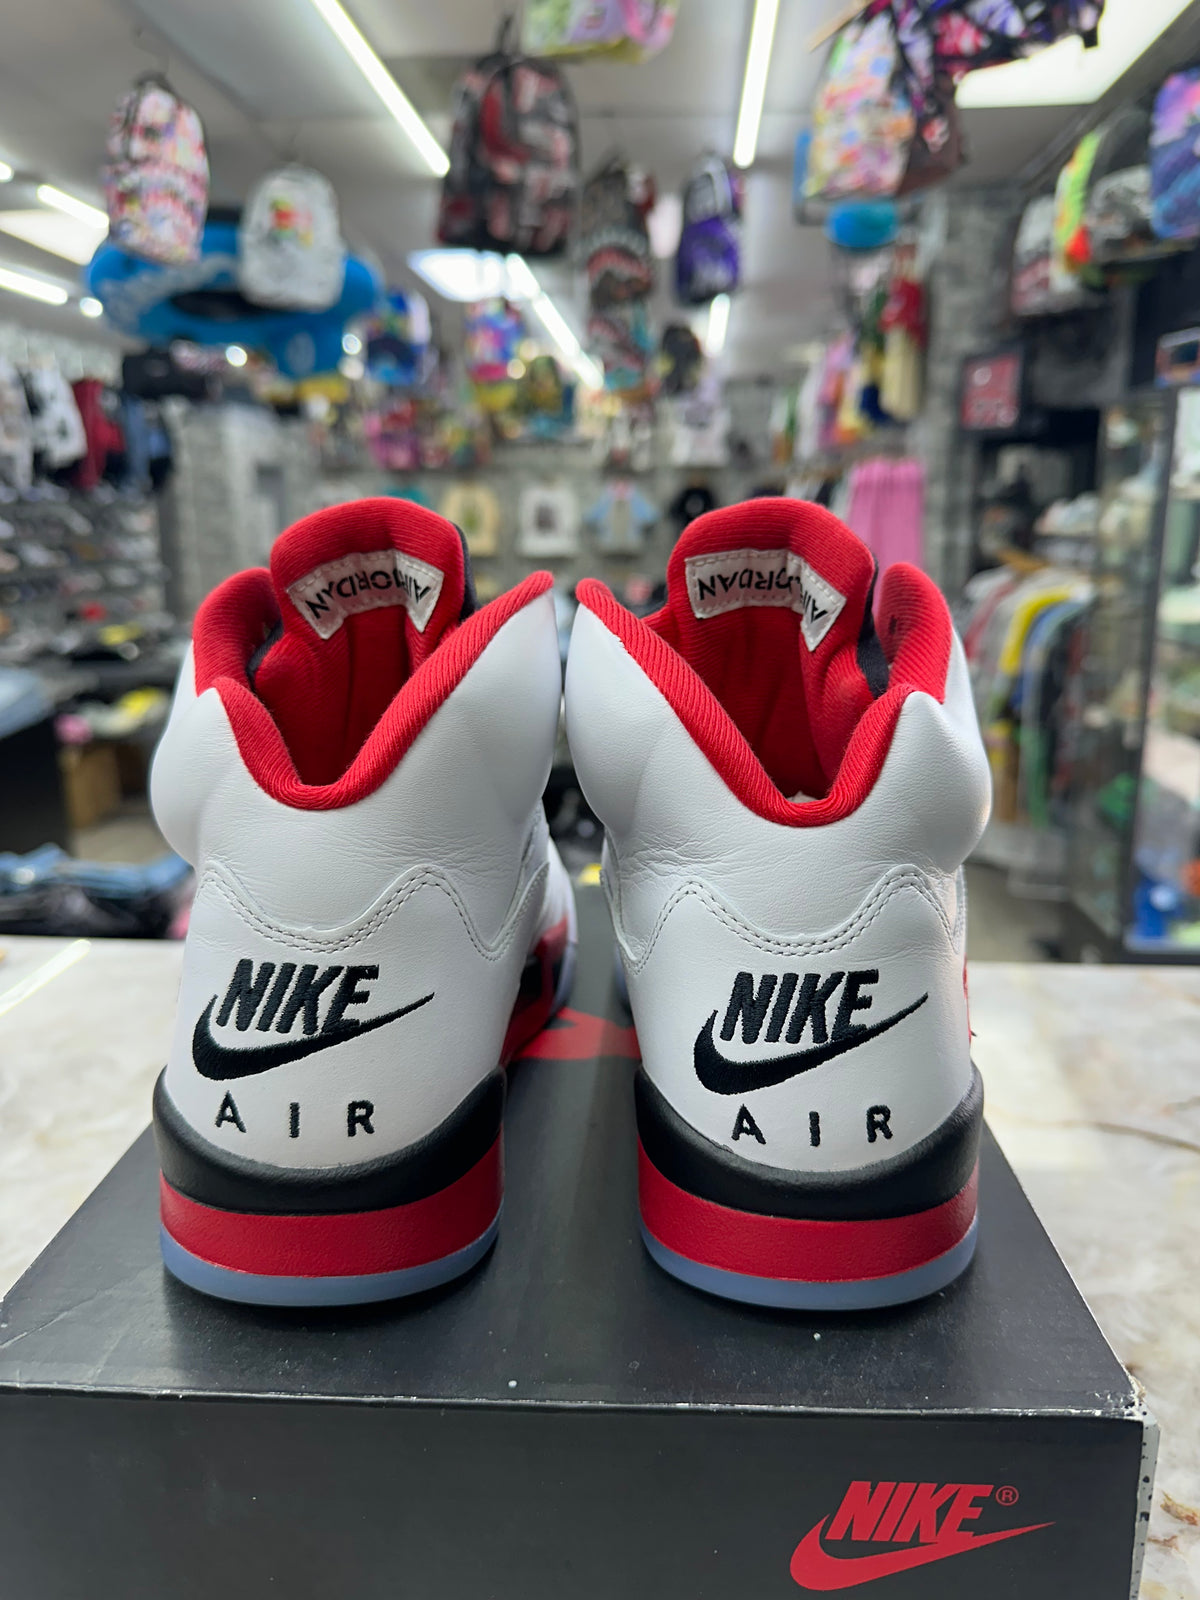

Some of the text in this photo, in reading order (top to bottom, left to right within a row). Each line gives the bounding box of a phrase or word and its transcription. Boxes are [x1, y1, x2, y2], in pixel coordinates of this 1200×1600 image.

[216, 958, 379, 1036] NIKE
[719, 968, 879, 1044] NIKE
[215, 1090, 375, 1138] AIR
[731, 1103, 893, 1147] AIR
